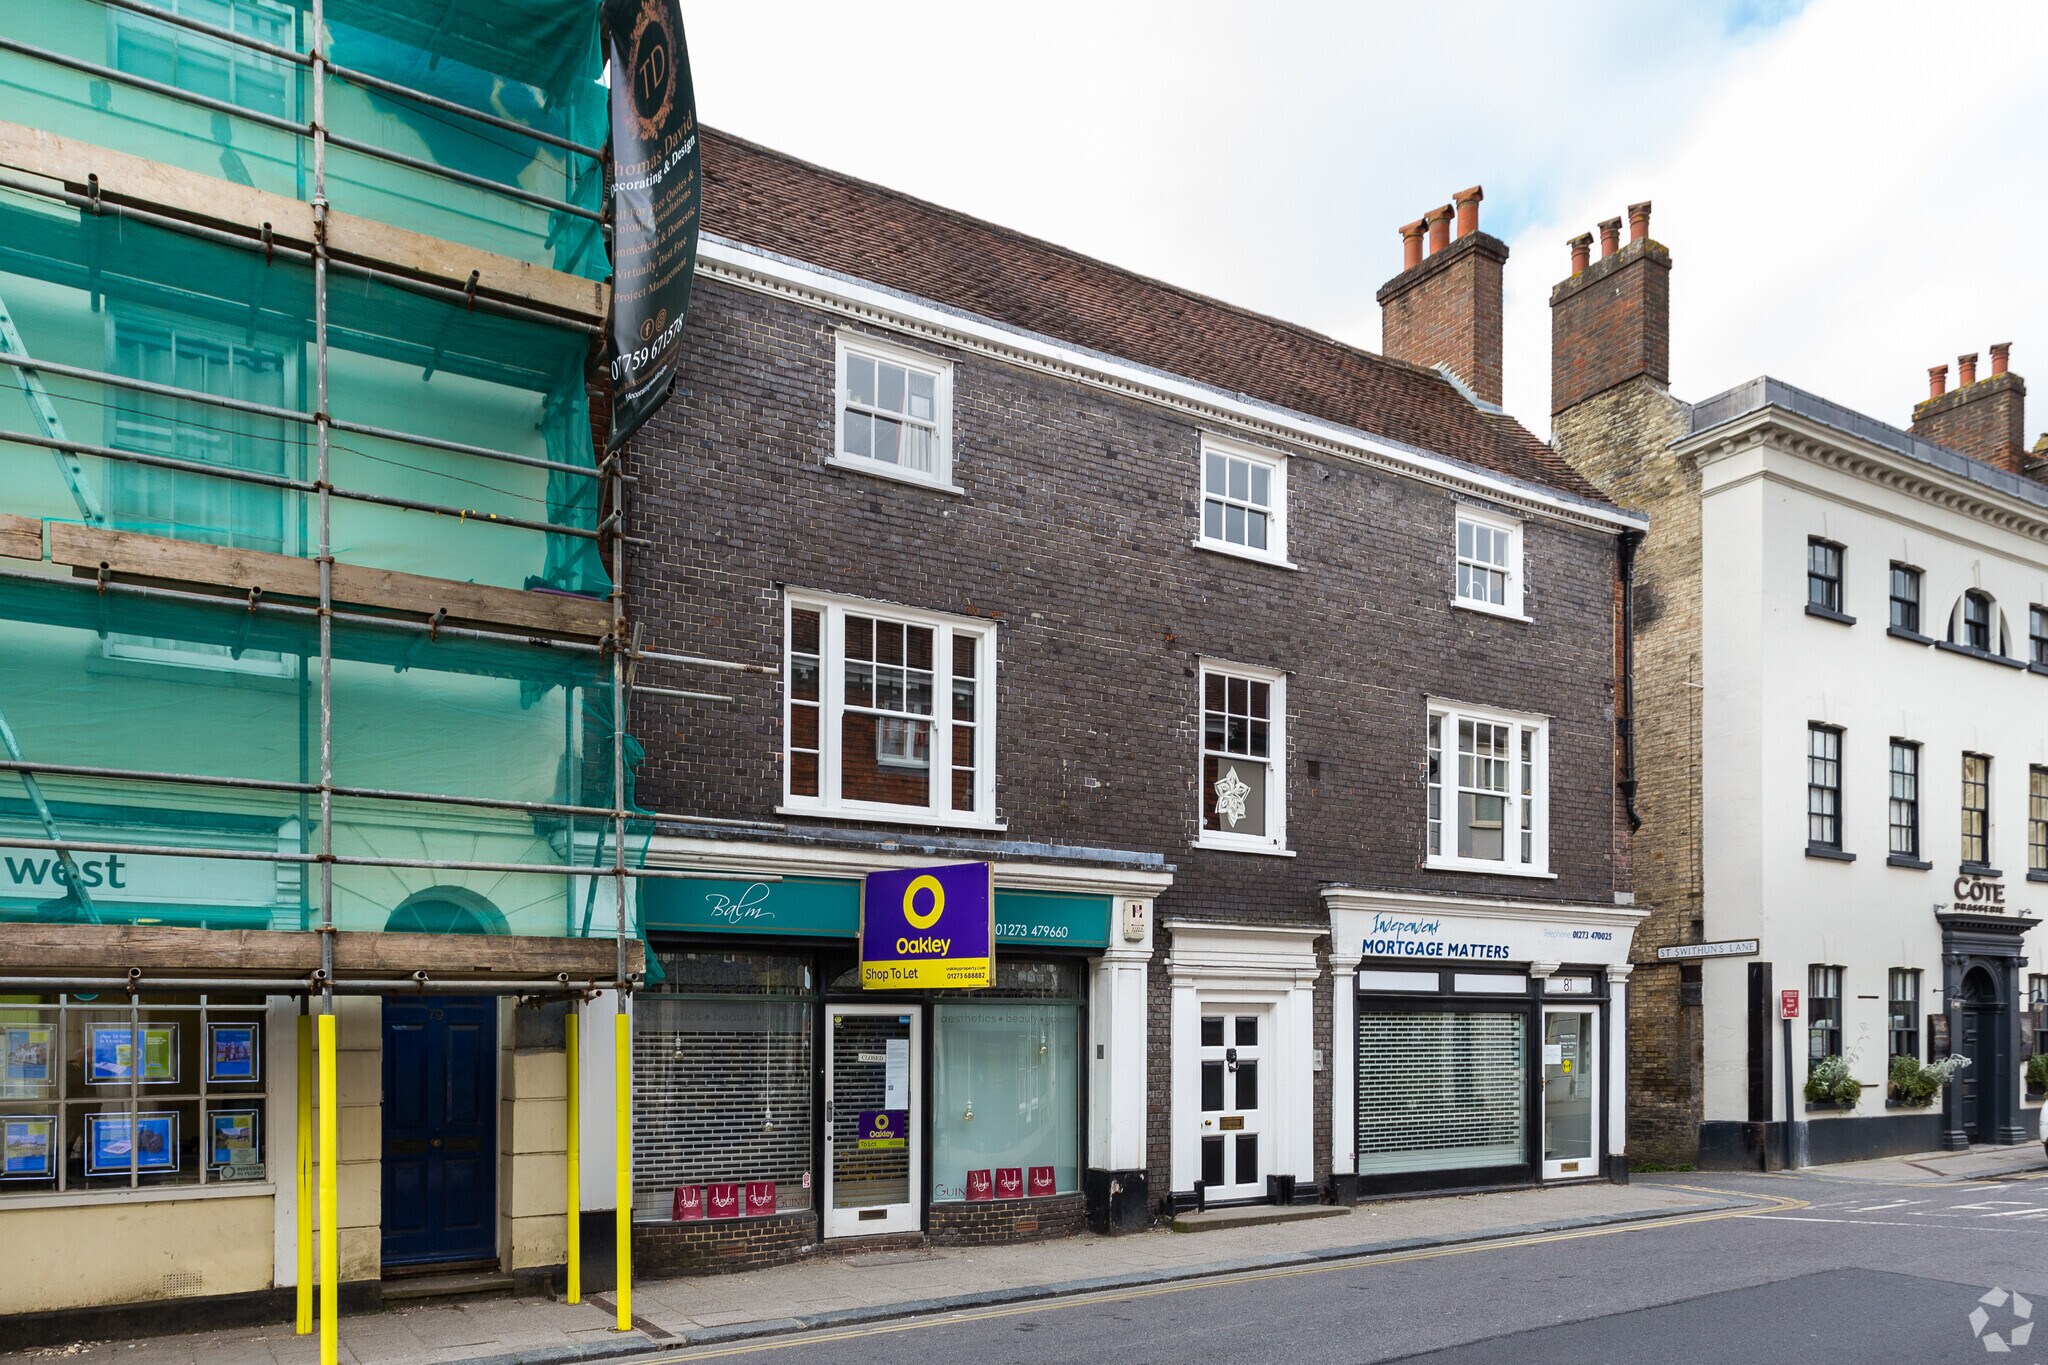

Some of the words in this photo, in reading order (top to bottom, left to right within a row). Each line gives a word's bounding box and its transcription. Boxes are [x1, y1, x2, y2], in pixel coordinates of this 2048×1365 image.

[639, 44, 665, 99] TD
[614, 150, 662, 177] homas
[664, 109, 693, 155] David
[663, 160, 671, 174] &
[671, 134, 696, 167] Design
[666, 177, 687, 202] Quotes
[614, 237, 659, 257] ommerical
[667, 205, 697, 237] Domestic
[618, 222, 644, 234] olour
[615, 261, 657, 279] Virtually
[658, 249, 674, 267] Dust
[674, 236, 688, 252] Free
[614, 286, 647, 304] Project
[648, 257, 688, 294] Management
[611, 346, 649, 381] 07759
[651, 312, 684, 360] 671578
[4, 855, 126, 889] west
[705, 882, 776, 924] Balm
[1954, 902, 2005, 913] BRASSERIE
[995, 923, 1028, 936] 01273
[1031, 925, 1069, 938] 479660
[1371, 911, 1442, 940] Independent
[1572, 930, 1589, 940] 01273
[1590, 931, 1613, 941] 470025
[896, 936, 951, 956] Oakley
[1362, 939, 1444, 957] MORTGAGE
[1447, 942, 1510, 959] MATTERS
[1660, 948, 1671, 957] ST
[1729, 942, 1755, 952] LANE
[865, 968, 889, 980] Shop
[890, 967, 902, 979] To
[903, 968, 918, 979] Let
[964, 971, 986, 979] 688882
[1562, 978, 1573, 992] 81
[636, 1009, 701, 1022] aesthetics
[712, 1009, 754, 1025] beauty
[940, 1012, 996, 1024] aesthetics
[1006, 1012, 1037, 1026] beauty
[869, 1129, 895, 1139] Oakley
